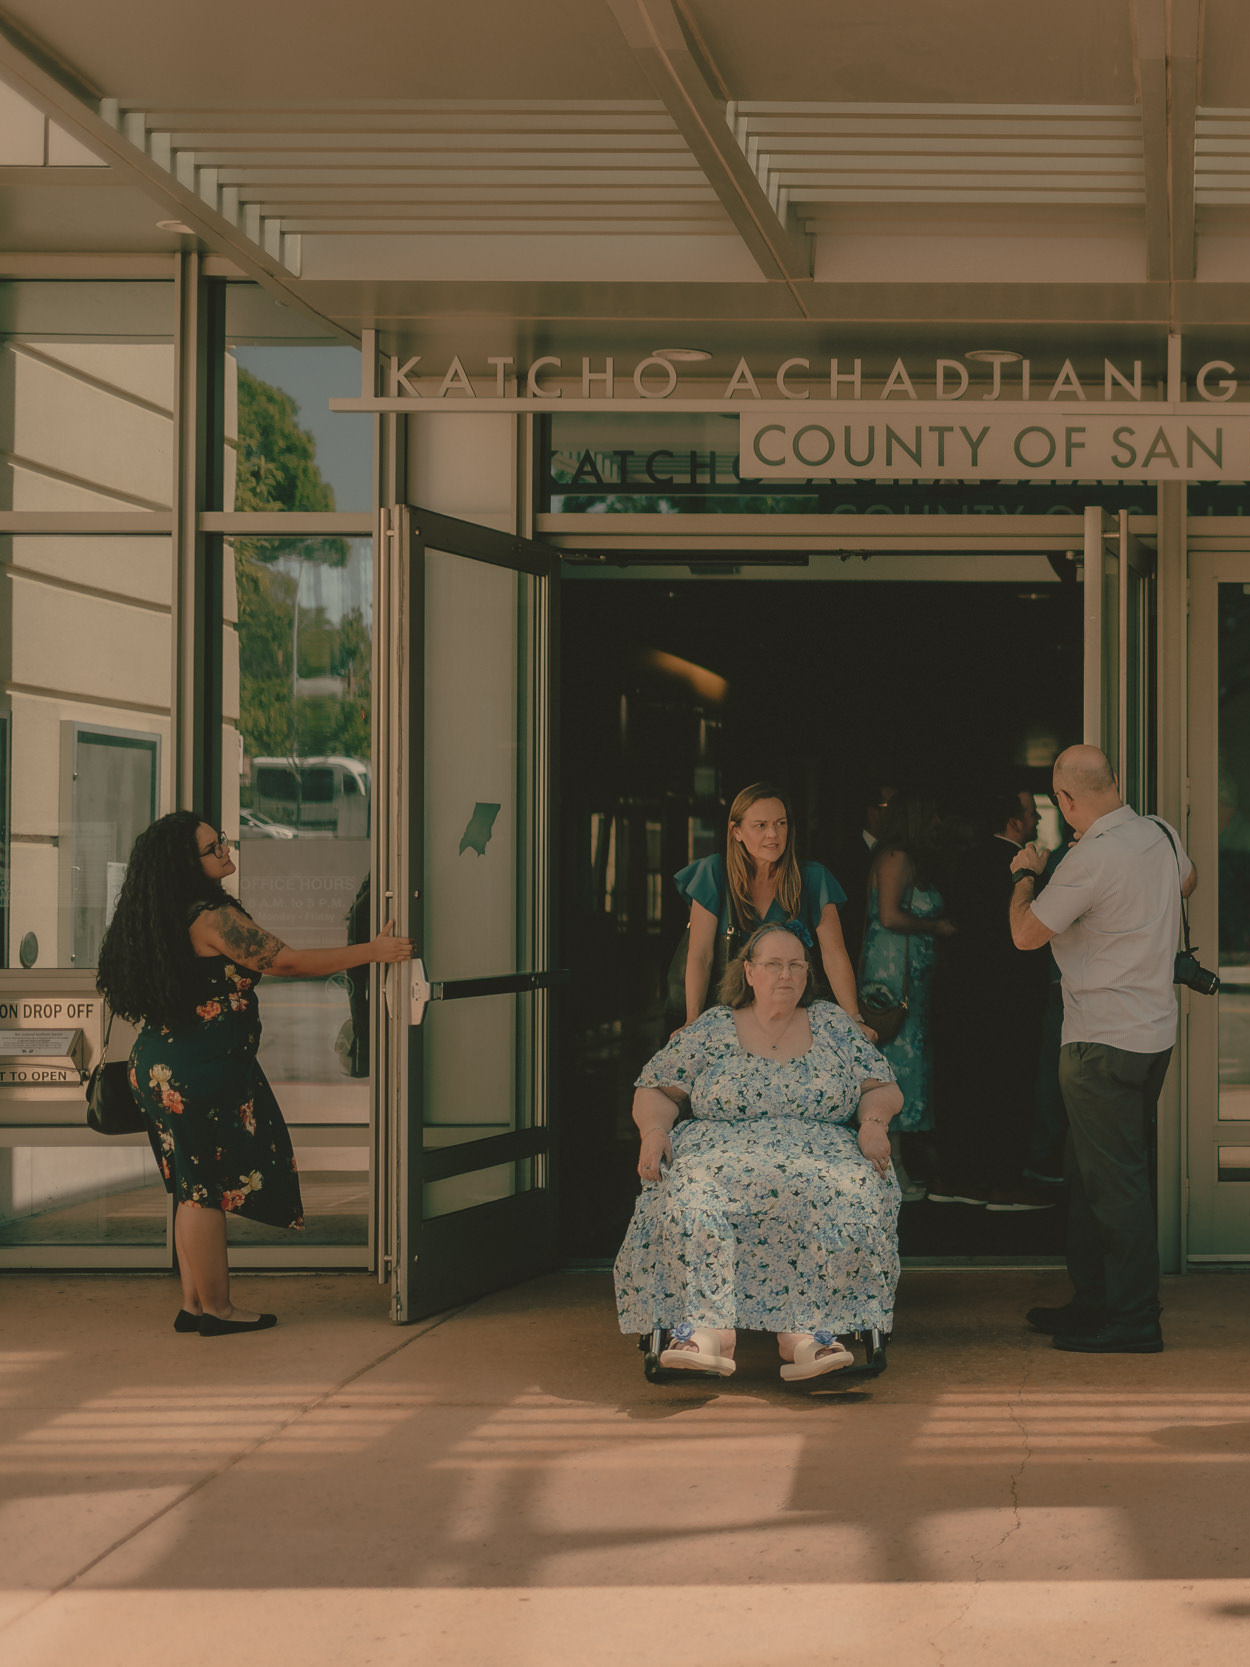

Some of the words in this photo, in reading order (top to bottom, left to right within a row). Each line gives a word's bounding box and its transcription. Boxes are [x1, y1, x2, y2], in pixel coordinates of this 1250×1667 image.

[390, 355, 681, 399] KATCHO
[723, 357, 1144, 401] ACHADJIAN
[751, 424, 992, 468] COUNTY
[1013, 425, 1087, 469] OF
[1110, 425, 1223, 471] SAN
[241, 878, 297, 891] OFFICE
[301, 878, 355, 891] HOURS
[23, 1003, 62, 1019] DROP
[67, 1003, 94, 1019] OFF
[9, 1071, 27, 1081] TO
[31, 1071, 67, 1081] OPEN
